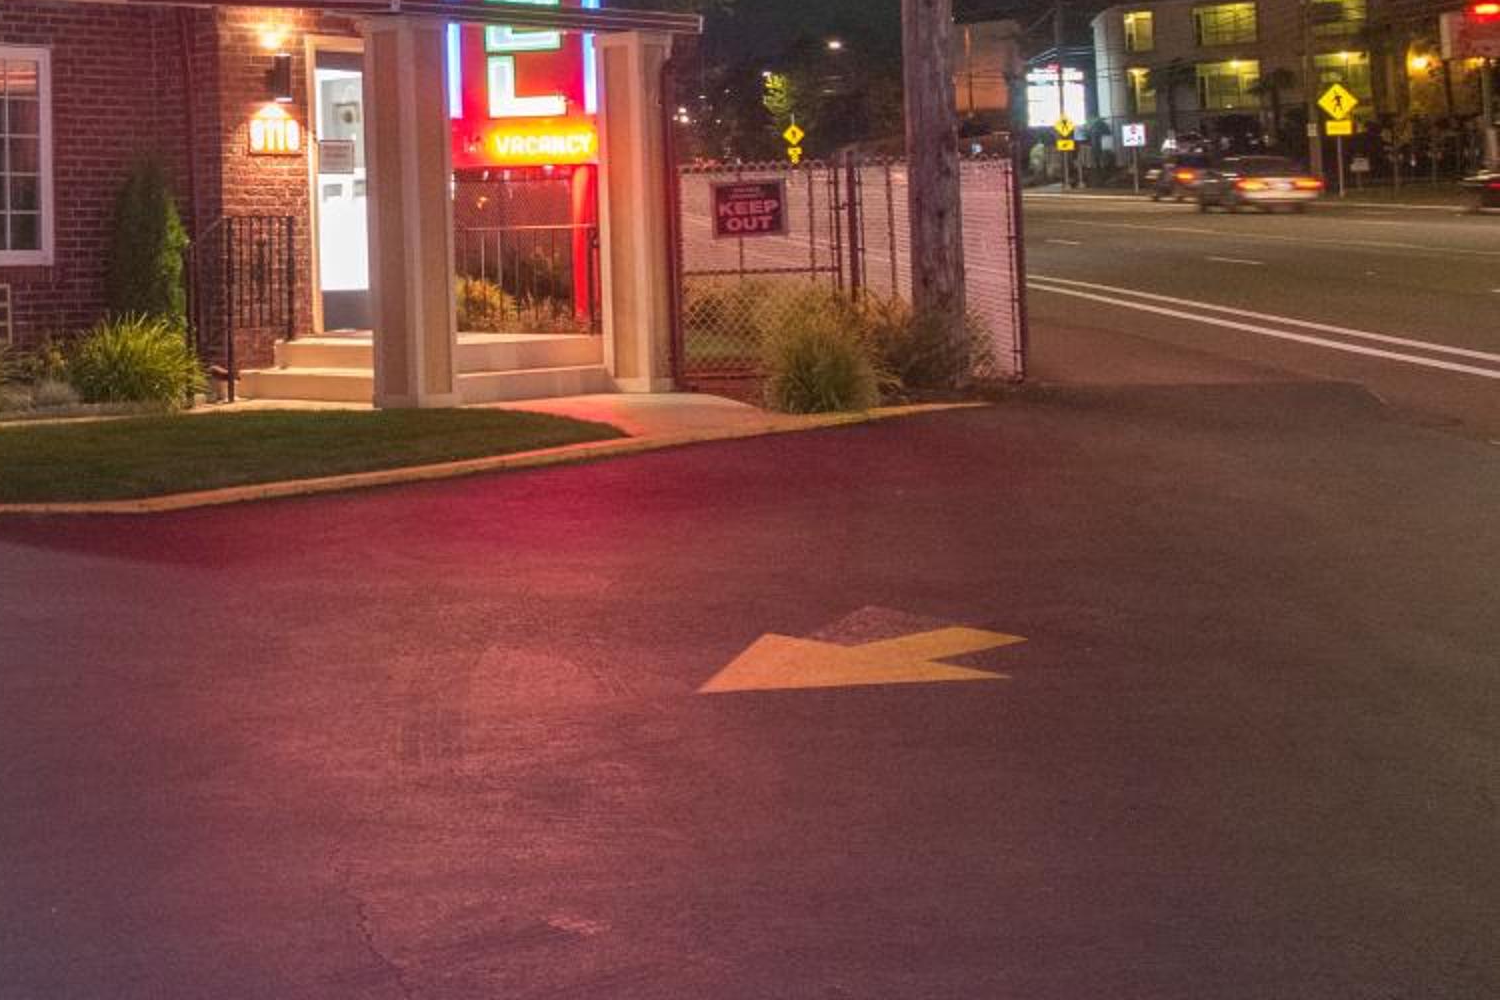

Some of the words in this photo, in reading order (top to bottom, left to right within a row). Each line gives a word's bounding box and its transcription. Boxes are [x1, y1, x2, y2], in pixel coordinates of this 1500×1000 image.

[495, 132, 594, 153] VACANCY
[719, 199, 779, 216] KEEP
[725, 215, 773, 231] OUT
